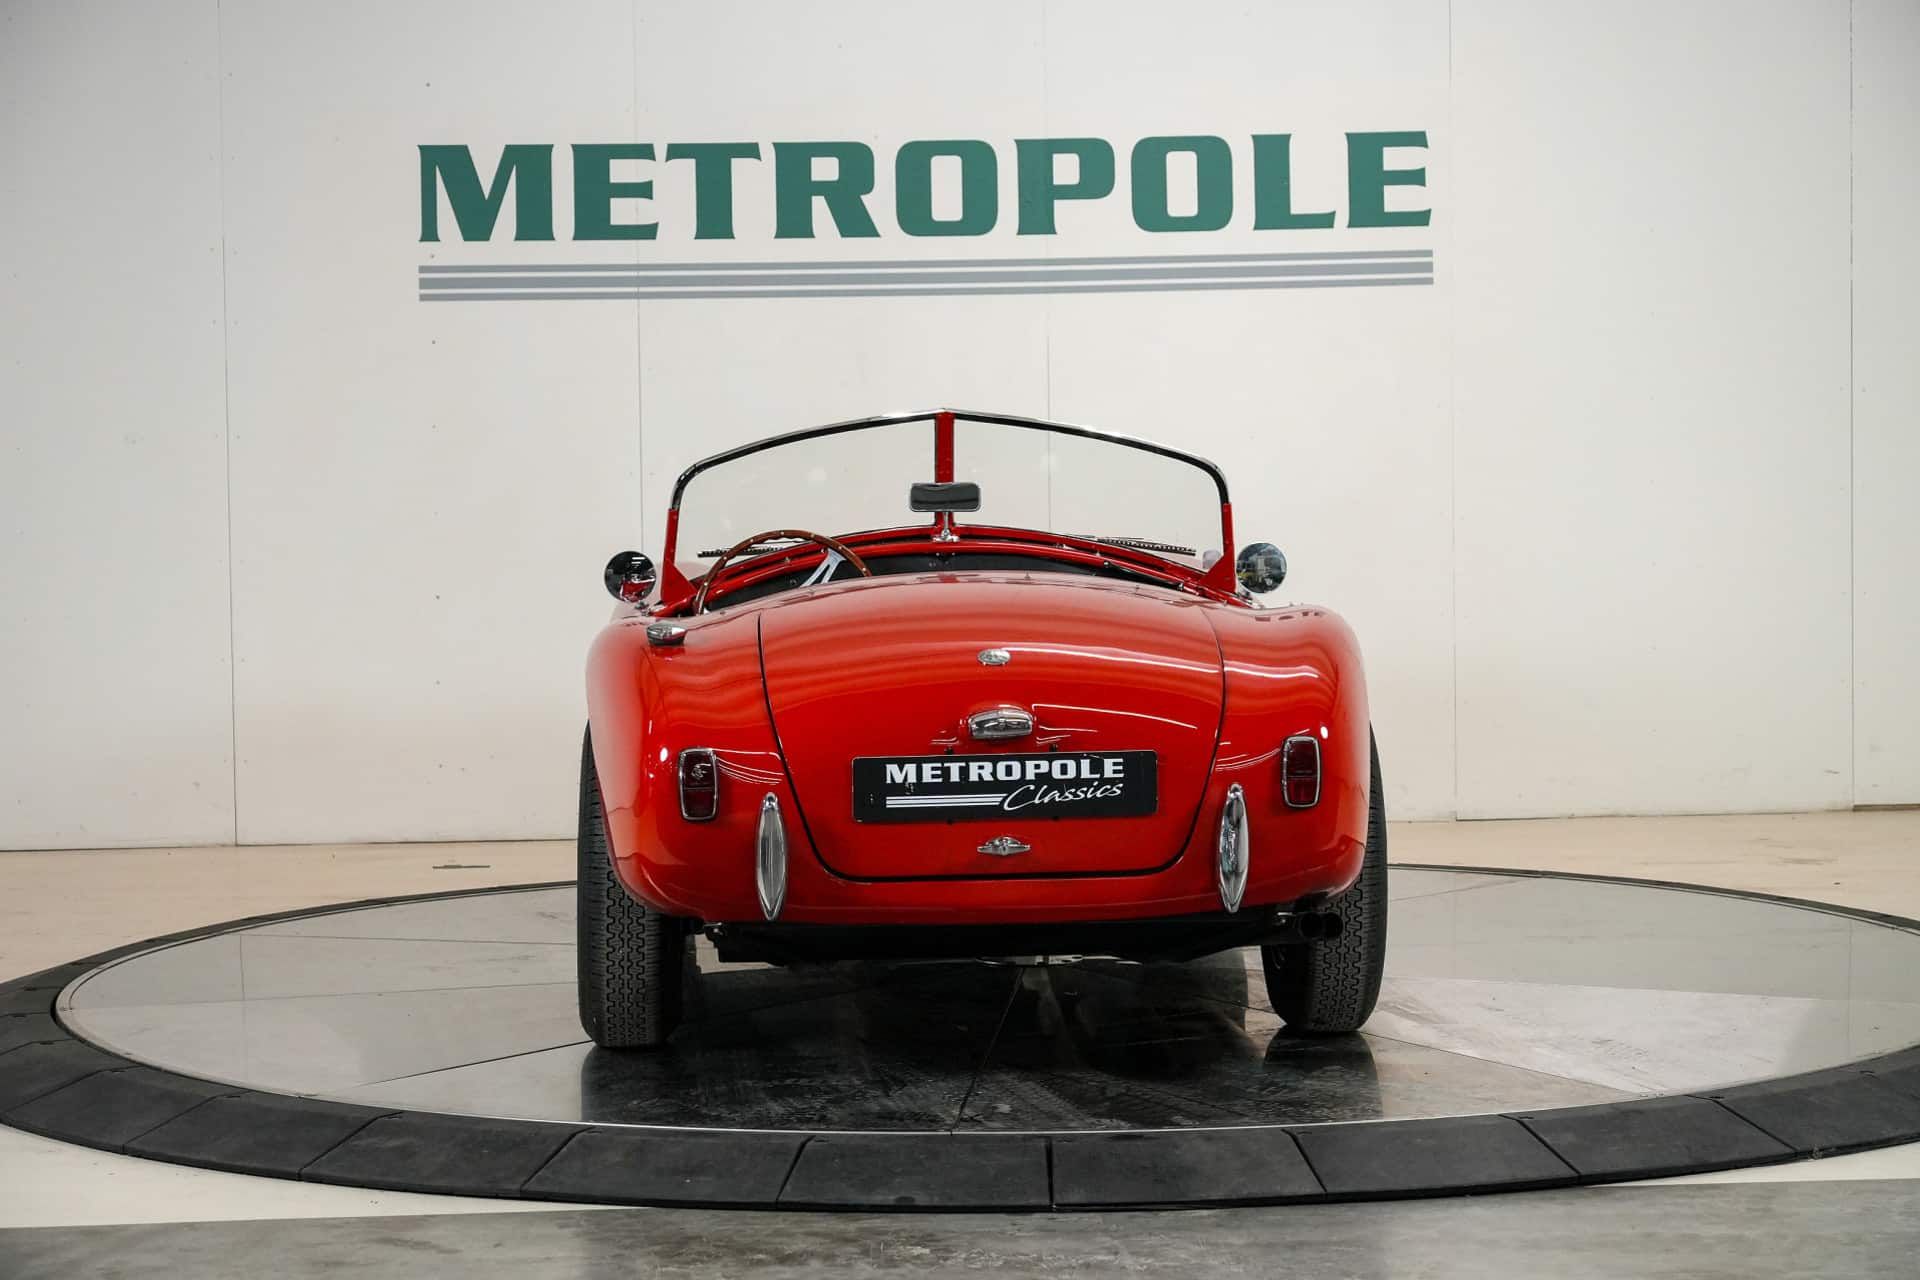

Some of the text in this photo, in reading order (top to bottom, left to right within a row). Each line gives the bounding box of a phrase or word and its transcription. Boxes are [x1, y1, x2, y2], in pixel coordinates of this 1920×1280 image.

[418, 131, 1431, 241] METROPOLE
[886, 758, 1125, 783] METROPOLE
[1003, 781, 1124, 811] Classics
